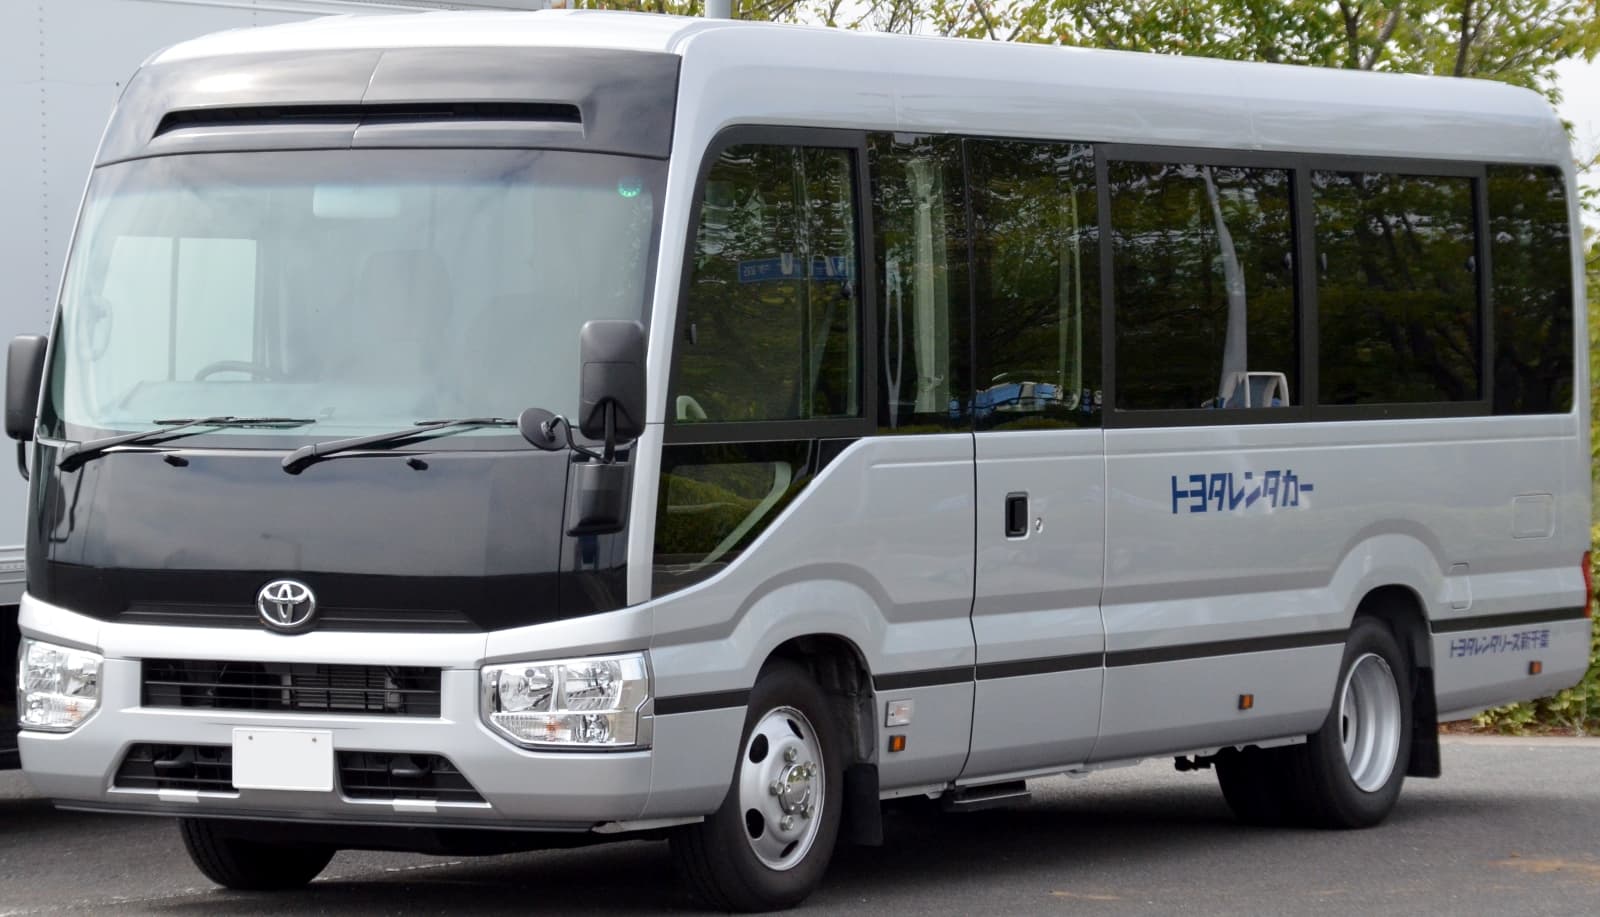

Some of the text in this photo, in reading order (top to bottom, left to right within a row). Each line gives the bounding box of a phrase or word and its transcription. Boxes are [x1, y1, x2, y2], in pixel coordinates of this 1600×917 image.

[1171, 469, 1314, 514] トヨタレンタカー
